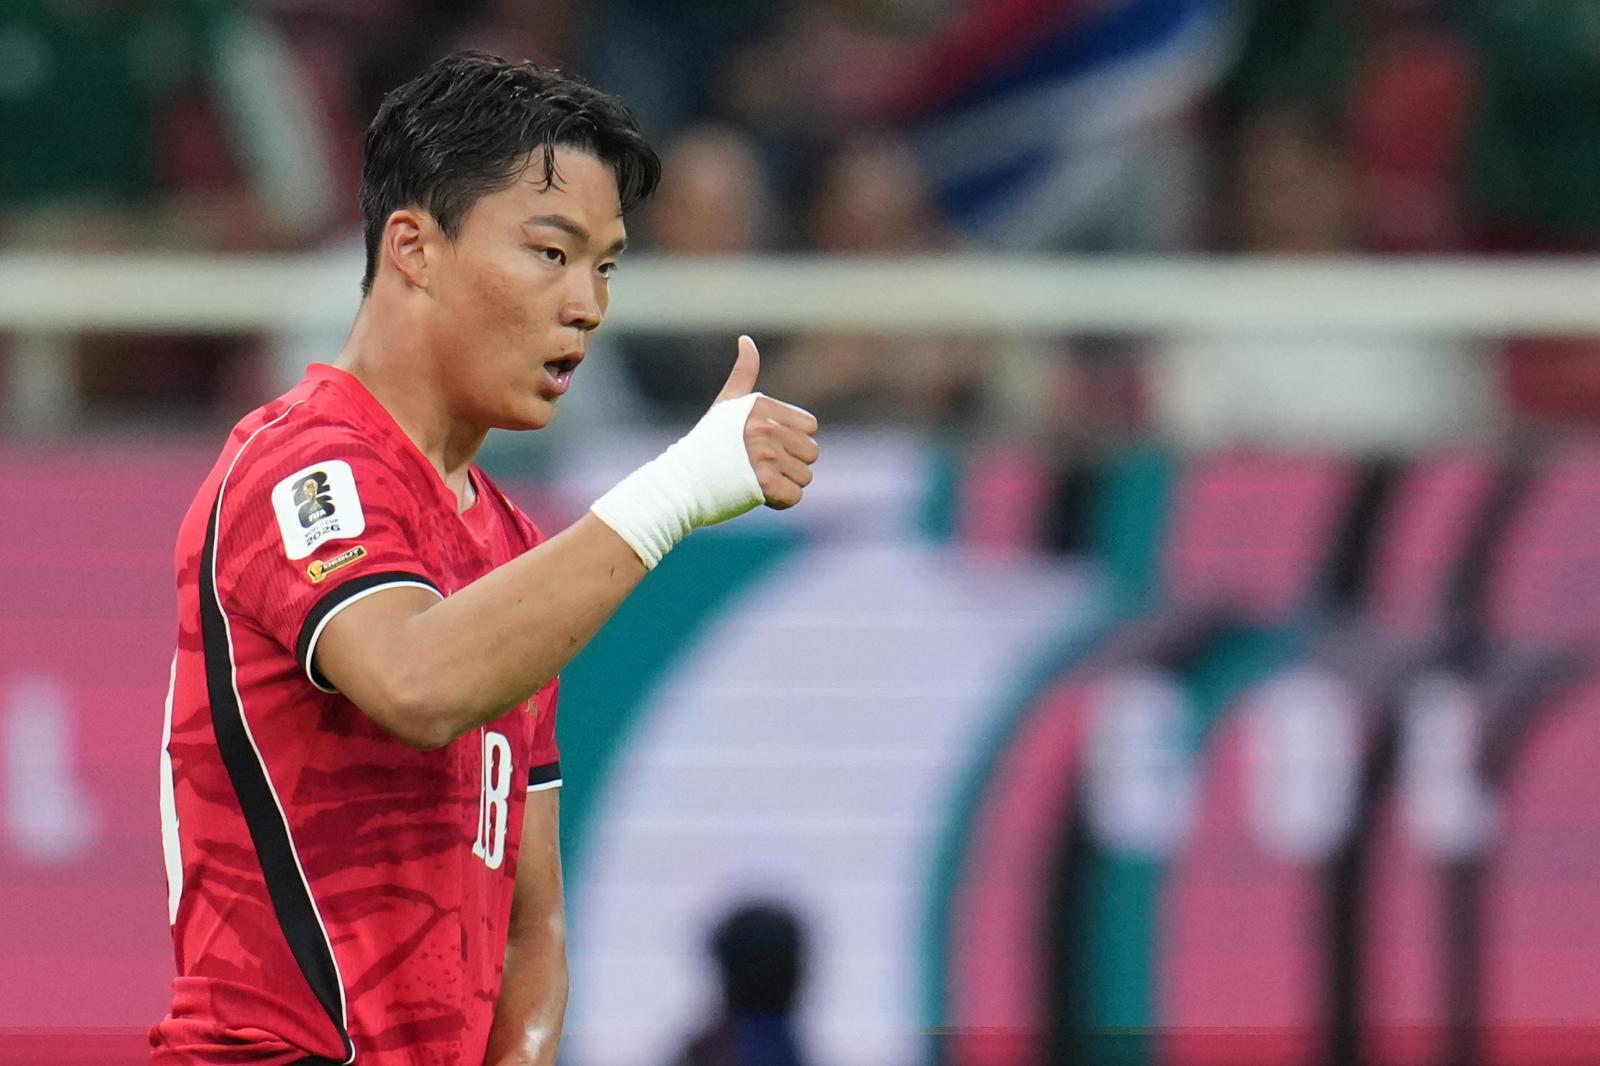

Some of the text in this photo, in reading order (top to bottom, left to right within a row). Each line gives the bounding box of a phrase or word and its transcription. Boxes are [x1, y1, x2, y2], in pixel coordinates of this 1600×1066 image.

[308, 508, 327, 522] FIFA
[306, 524, 341, 546] 2026
[323, 548, 360, 570] DEBUT
[472, 726, 513, 870] 18
